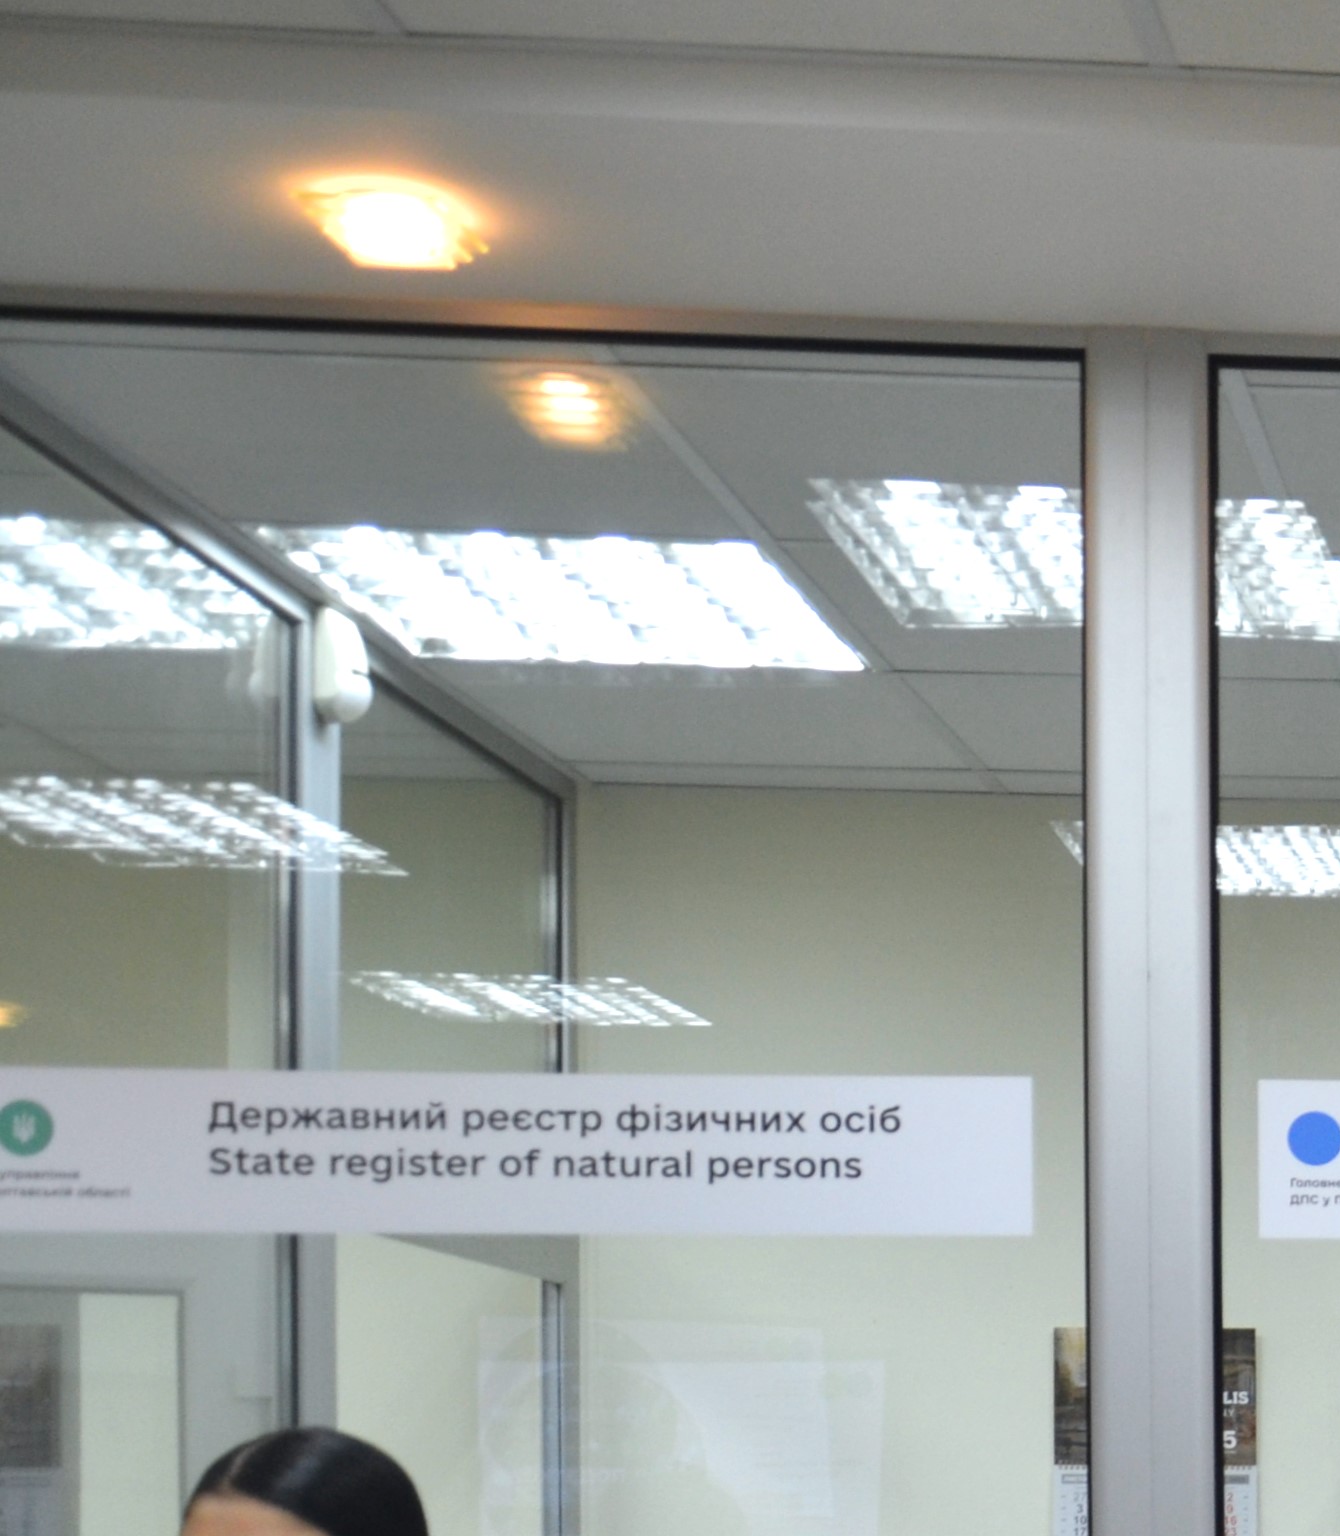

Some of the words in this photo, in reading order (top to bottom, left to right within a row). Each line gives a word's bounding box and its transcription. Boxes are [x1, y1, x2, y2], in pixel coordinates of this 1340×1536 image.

[208, 1101, 447, 1136] Державний
[462, 1108, 603, 1137] реєстр
[616, 1103, 805, 1138] фізичних
[820, 1104, 901, 1134] осіб
[209, 1147, 315, 1176] State
[329, 1147, 486, 1184] register
[499, 1148, 541, 1178] of
[553, 1149, 692, 1179] natural
[707, 1156, 862, 1185] persons
[1290, 1195, 1319, 1206] ДПС
[1323, 1196, 1331, 1207] у
[1075, 1516, 1087, 1525] 10
[1074, 1527, 1087, 1536] 17
